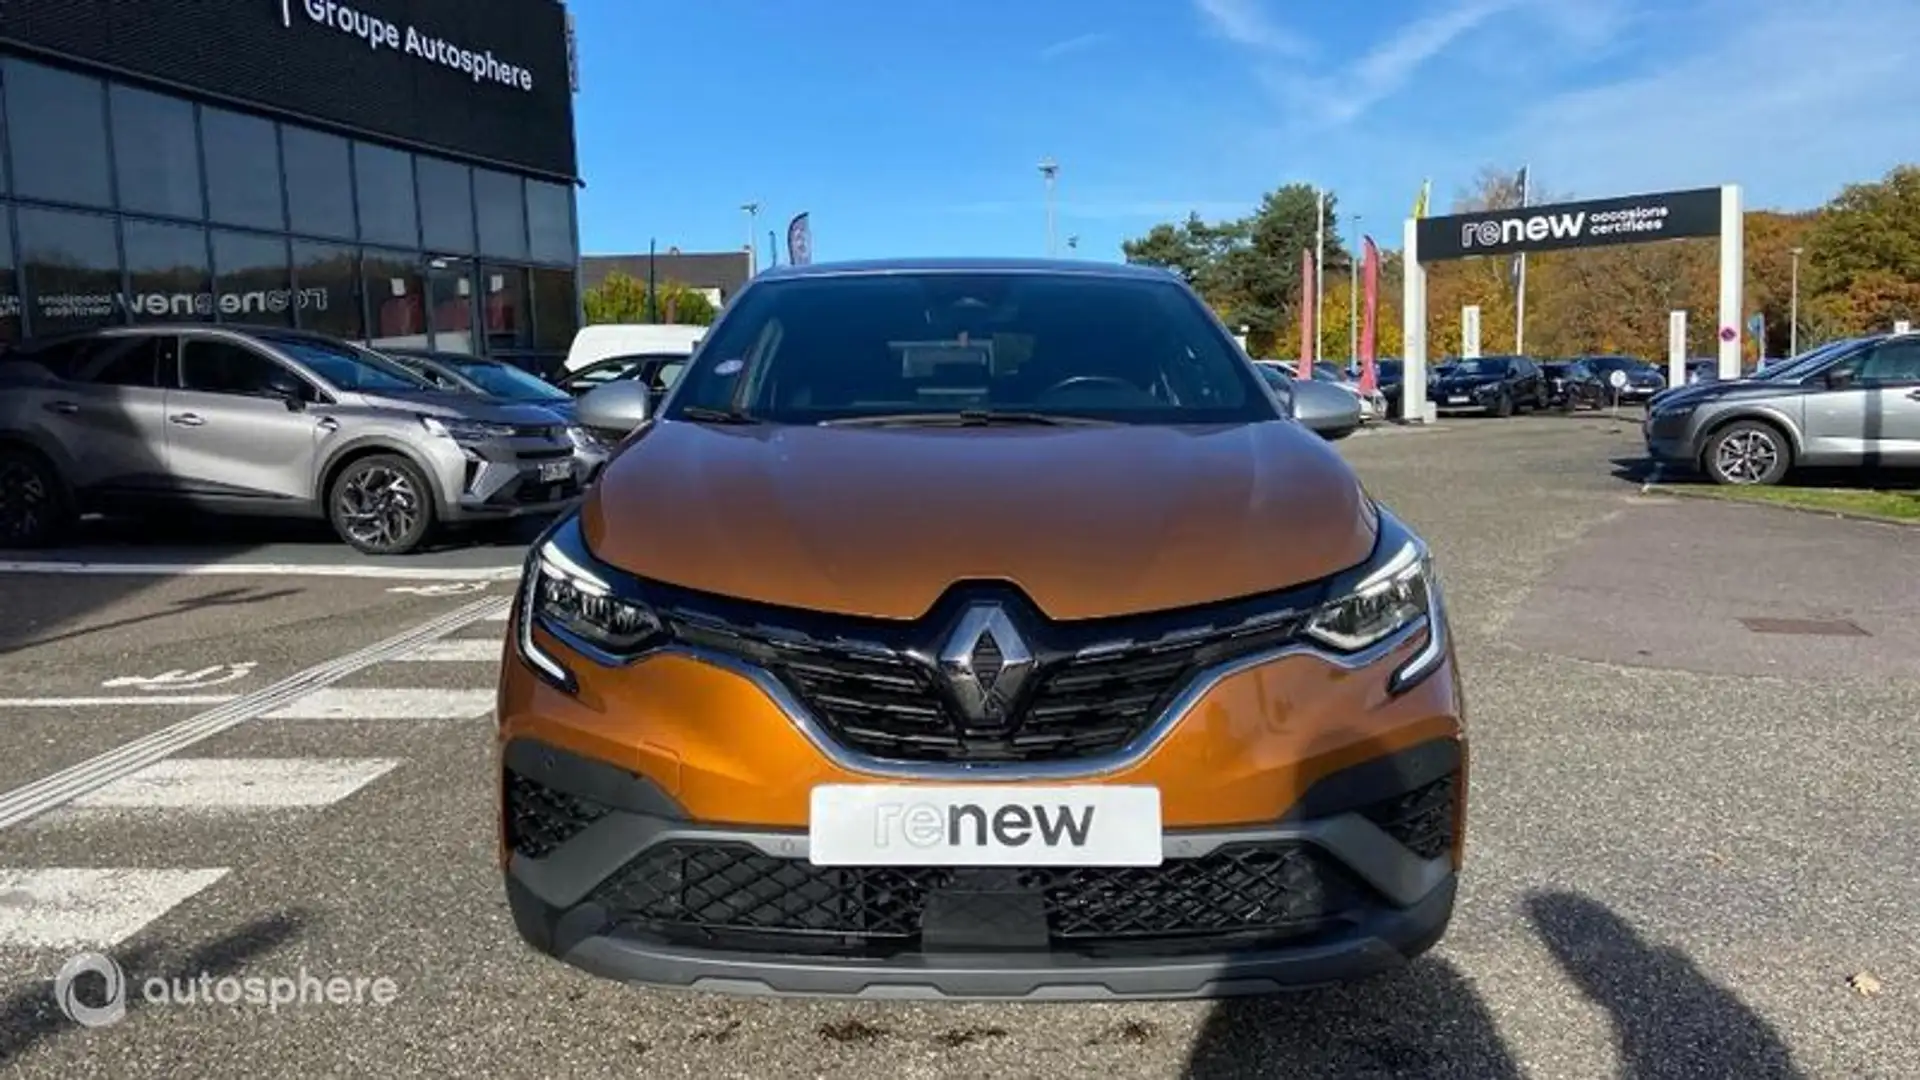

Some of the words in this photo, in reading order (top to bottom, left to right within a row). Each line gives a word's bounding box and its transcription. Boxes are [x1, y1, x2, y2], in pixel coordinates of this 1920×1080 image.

[305, 0, 400, 48] Groupe
[404, 26, 532, 90] Autosphere
[1461, 211, 1586, 248] renew
[1590, 206, 1669, 222] occasions
[873, 801, 1095, 848] renew
